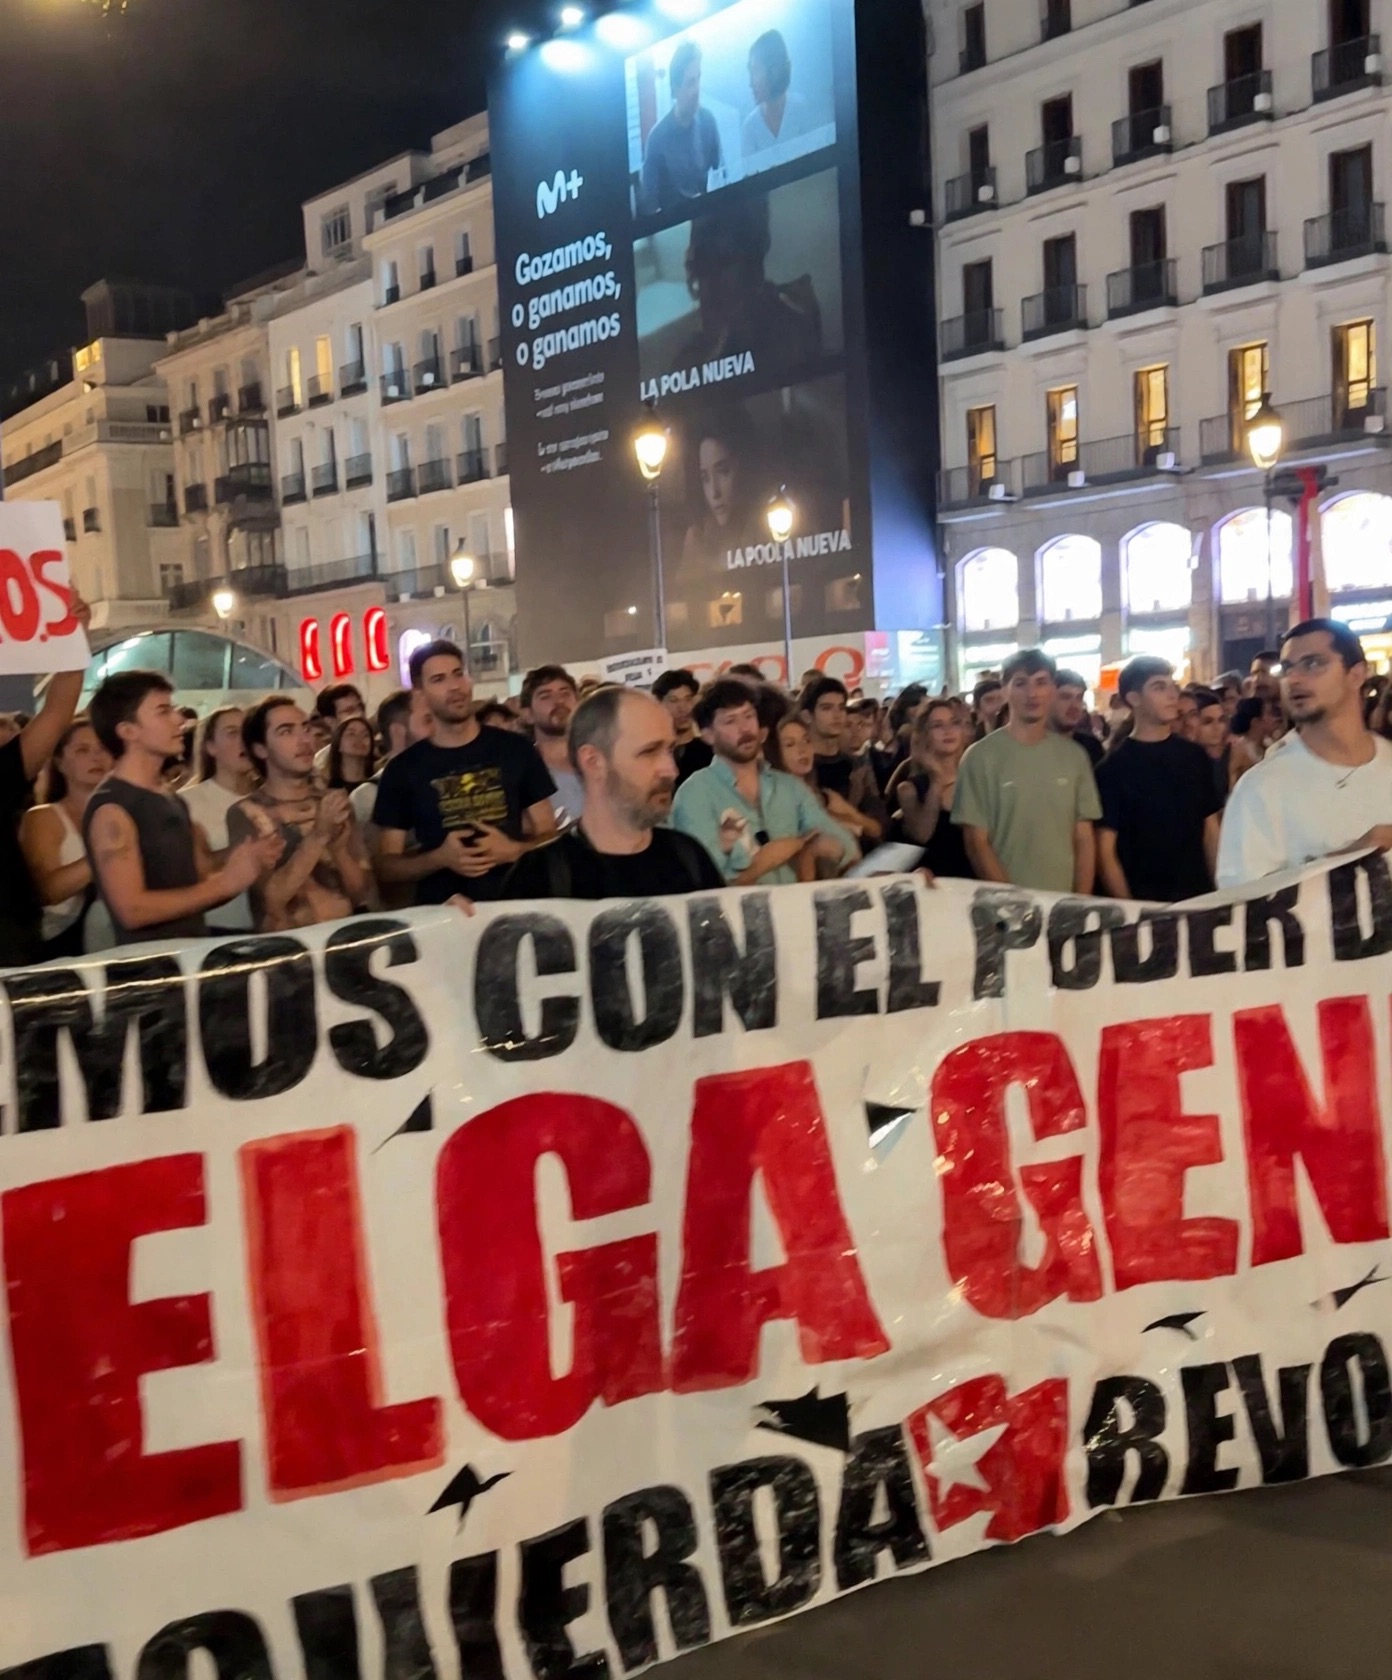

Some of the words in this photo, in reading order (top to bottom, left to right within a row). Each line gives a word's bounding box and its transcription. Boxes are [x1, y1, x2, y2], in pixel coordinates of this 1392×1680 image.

[536, 169, 583, 219] M+
[515, 231, 612, 286] Gozamos,
[511, 303, 525, 328] o
[528, 270, 621, 330] ganamos,
[516, 342, 529, 366] o
[532, 312, 620, 370] ganamos
[640, 378, 659, 401] LA
[660, 366, 700, 396] POLA
[702, 350, 755, 385] NUEVA
[727, 548, 745, 569] LA
[796, 529, 852, 558] NUEVA
[0, 919, 429, 1136] MOS
[472, 892, 779, 1062] CON
[812, 879, 942, 1020] EL
[0, 1058, 892, 1558] ELGA
[931, 994, 1392, 1320] GEN
[1082, 1332, 1392, 1510] REVO
